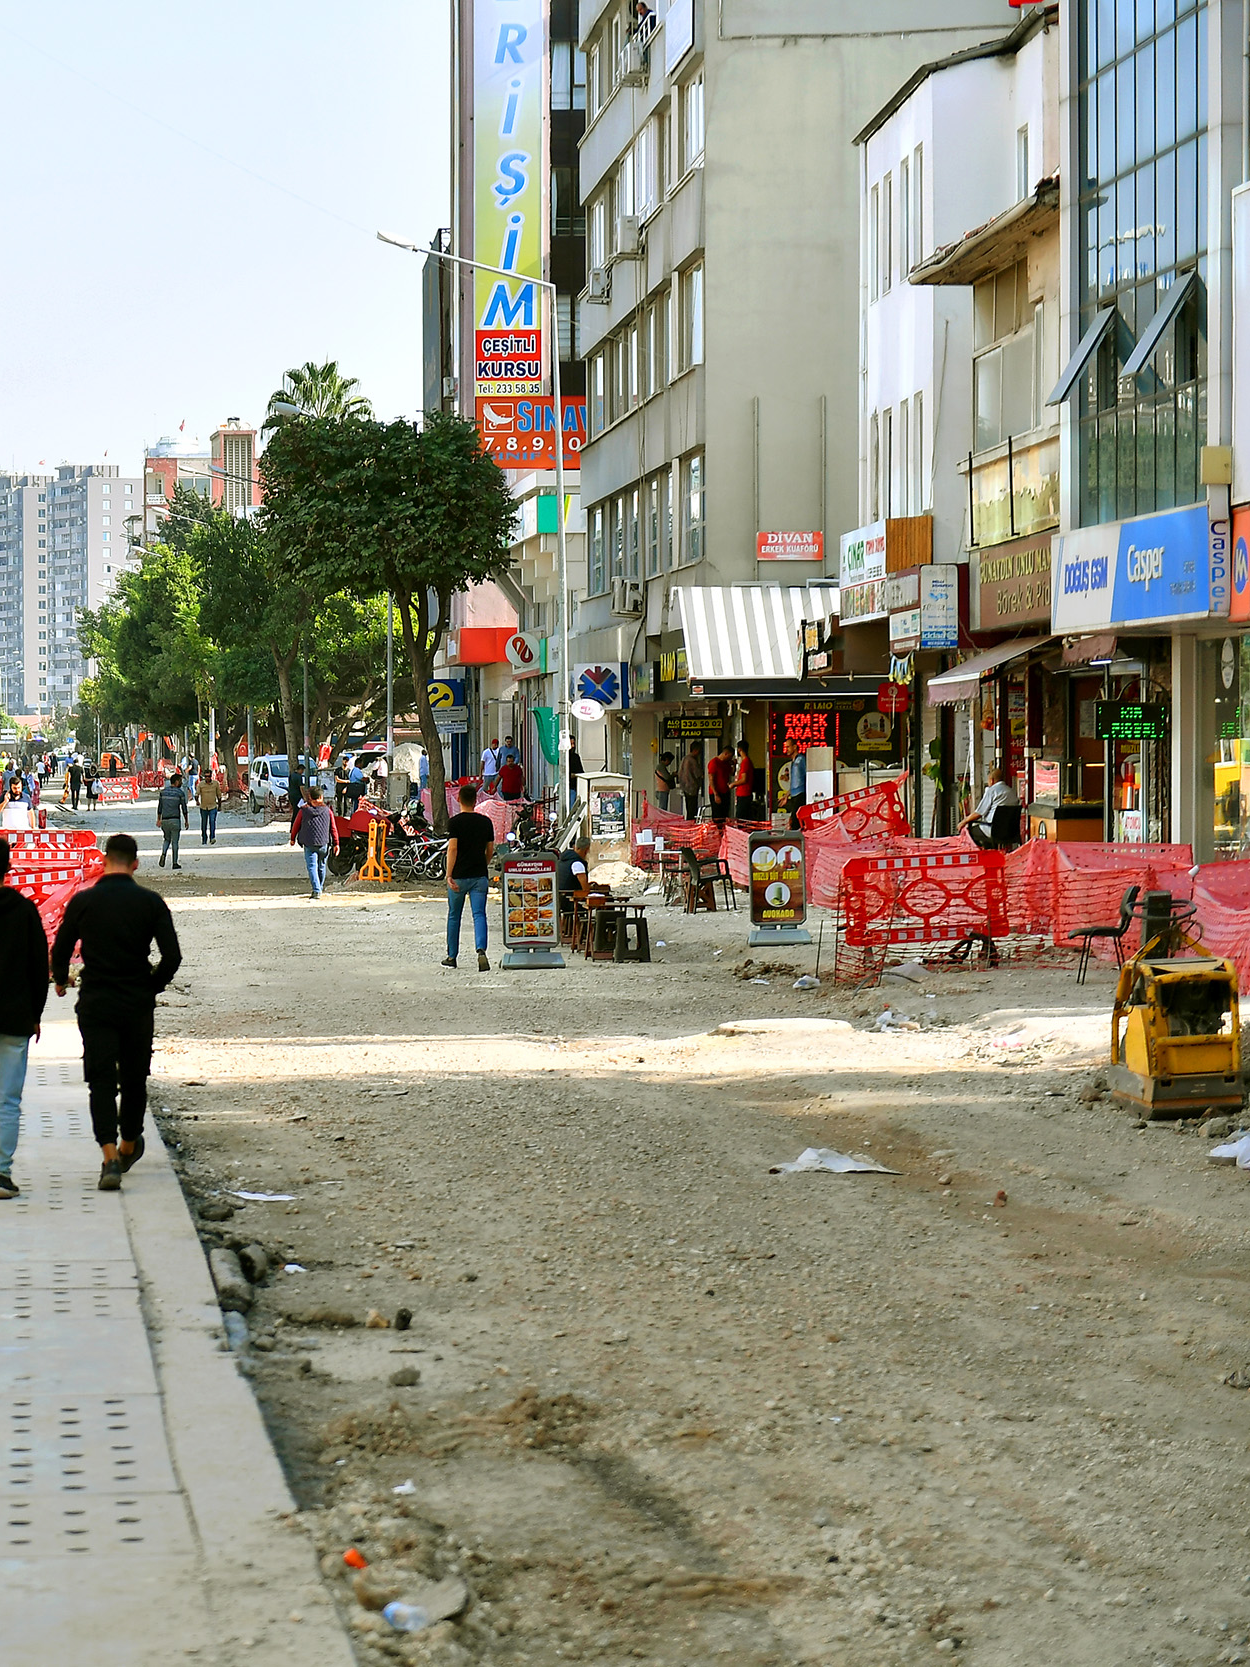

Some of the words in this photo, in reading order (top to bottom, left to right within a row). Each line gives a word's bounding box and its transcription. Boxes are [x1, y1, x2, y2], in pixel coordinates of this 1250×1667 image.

[483, 0, 539, 327] RİŞİM
[482, 335, 536, 357] ÇEŞİTLİ
[477, 361, 540, 378] KURSU
[478, 383, 494, 394] Tel:
[496, 383, 513, 394] 233
[515, 383, 526, 394] 58
[529, 383, 540, 394] 35
[767, 531, 814, 543] DİVAN
[761, 545, 784, 553] ERKEK
[786, 544, 819, 553] KUAFÖRÜ
[1091, 556, 1108, 590] GSM
[1127, 544, 1165, 592] Casper
[1210, 521, 1226, 612] Casper
[997, 584, 1023, 615] Börek
[1026, 582, 1034, 610] &
[804, 702, 833, 710] RAMO
[682, 720, 698, 728] 336
[699, 720, 710, 728] 50
[711, 720, 722, 728] 02
[784, 713, 828, 727] EKMEK
[785, 727, 826, 740] ARASI
[1010, 738, 1025, 747] +18
[782, 871, 799, 880] ATOM
[762, 909, 795, 918] AVOKADO
